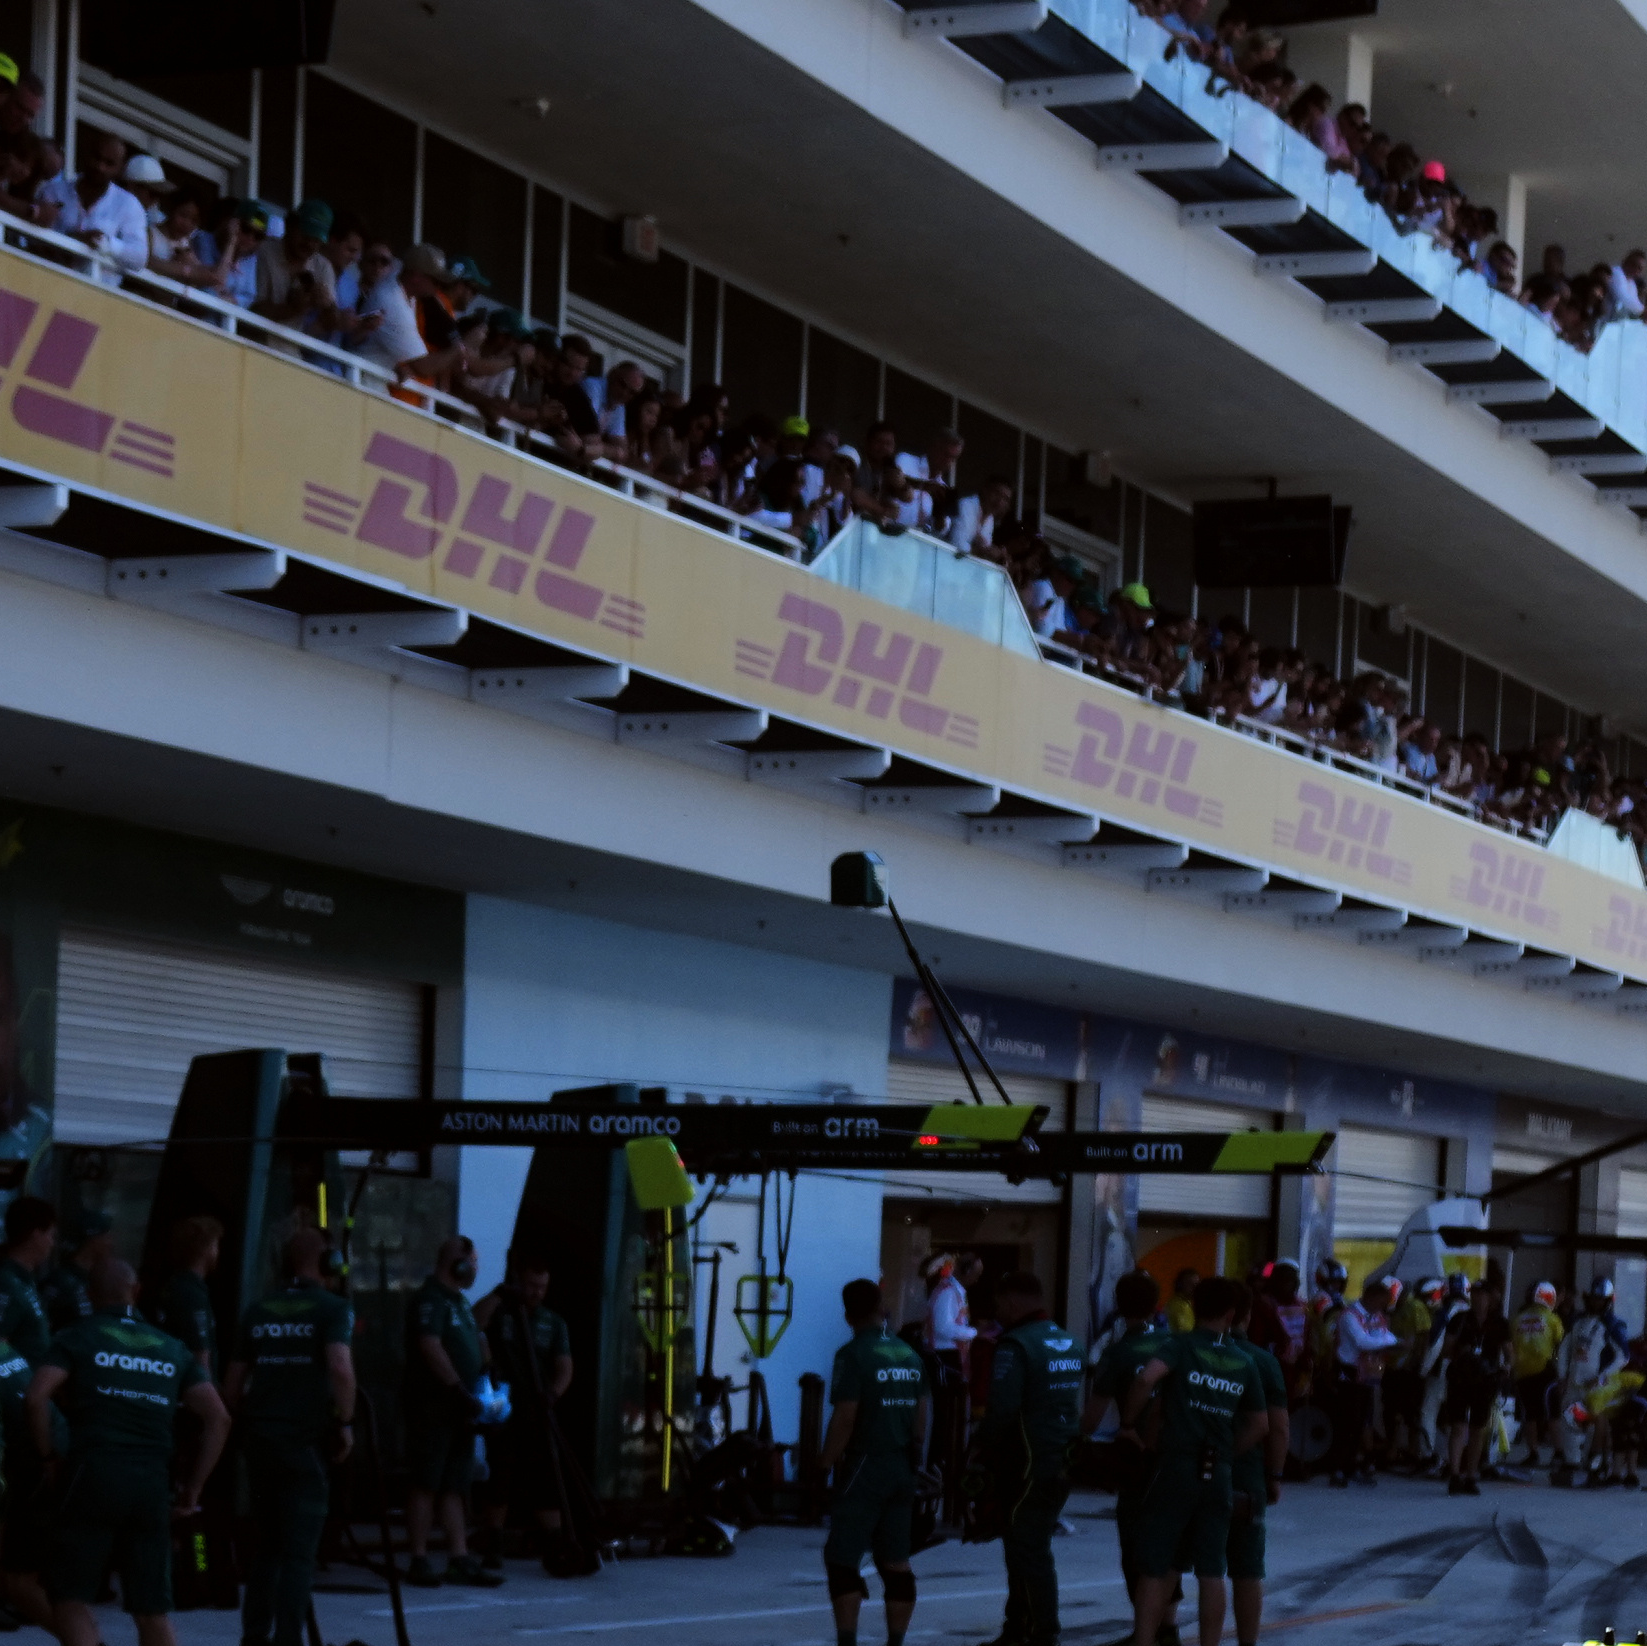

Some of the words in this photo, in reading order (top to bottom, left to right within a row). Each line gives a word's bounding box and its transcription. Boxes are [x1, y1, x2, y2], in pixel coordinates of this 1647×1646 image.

[355, 430, 605, 621] DHL
[771, 592, 955, 737] DHL
[1070, 702, 1199, 820] DHL
[1294, 782, 1394, 880] DHL
[1470, 840, 1546, 926] DHL
[441, 1112, 503, 1132] ASTON
[507, 1113, 581, 1133] MARTIN
[588, 1114, 681, 1135] aramco
[824, 1116, 879, 1139] arm
[1085, 1146, 1111, 1159] Built
[1113, 1149, 1128, 1159] on
[1132, 1140, 1183, 1163] arm
[94, 1351, 176, 1378] aramco
[876, 1368, 921, 1383] aramco
[1188, 1370, 1244, 1397] aramco
